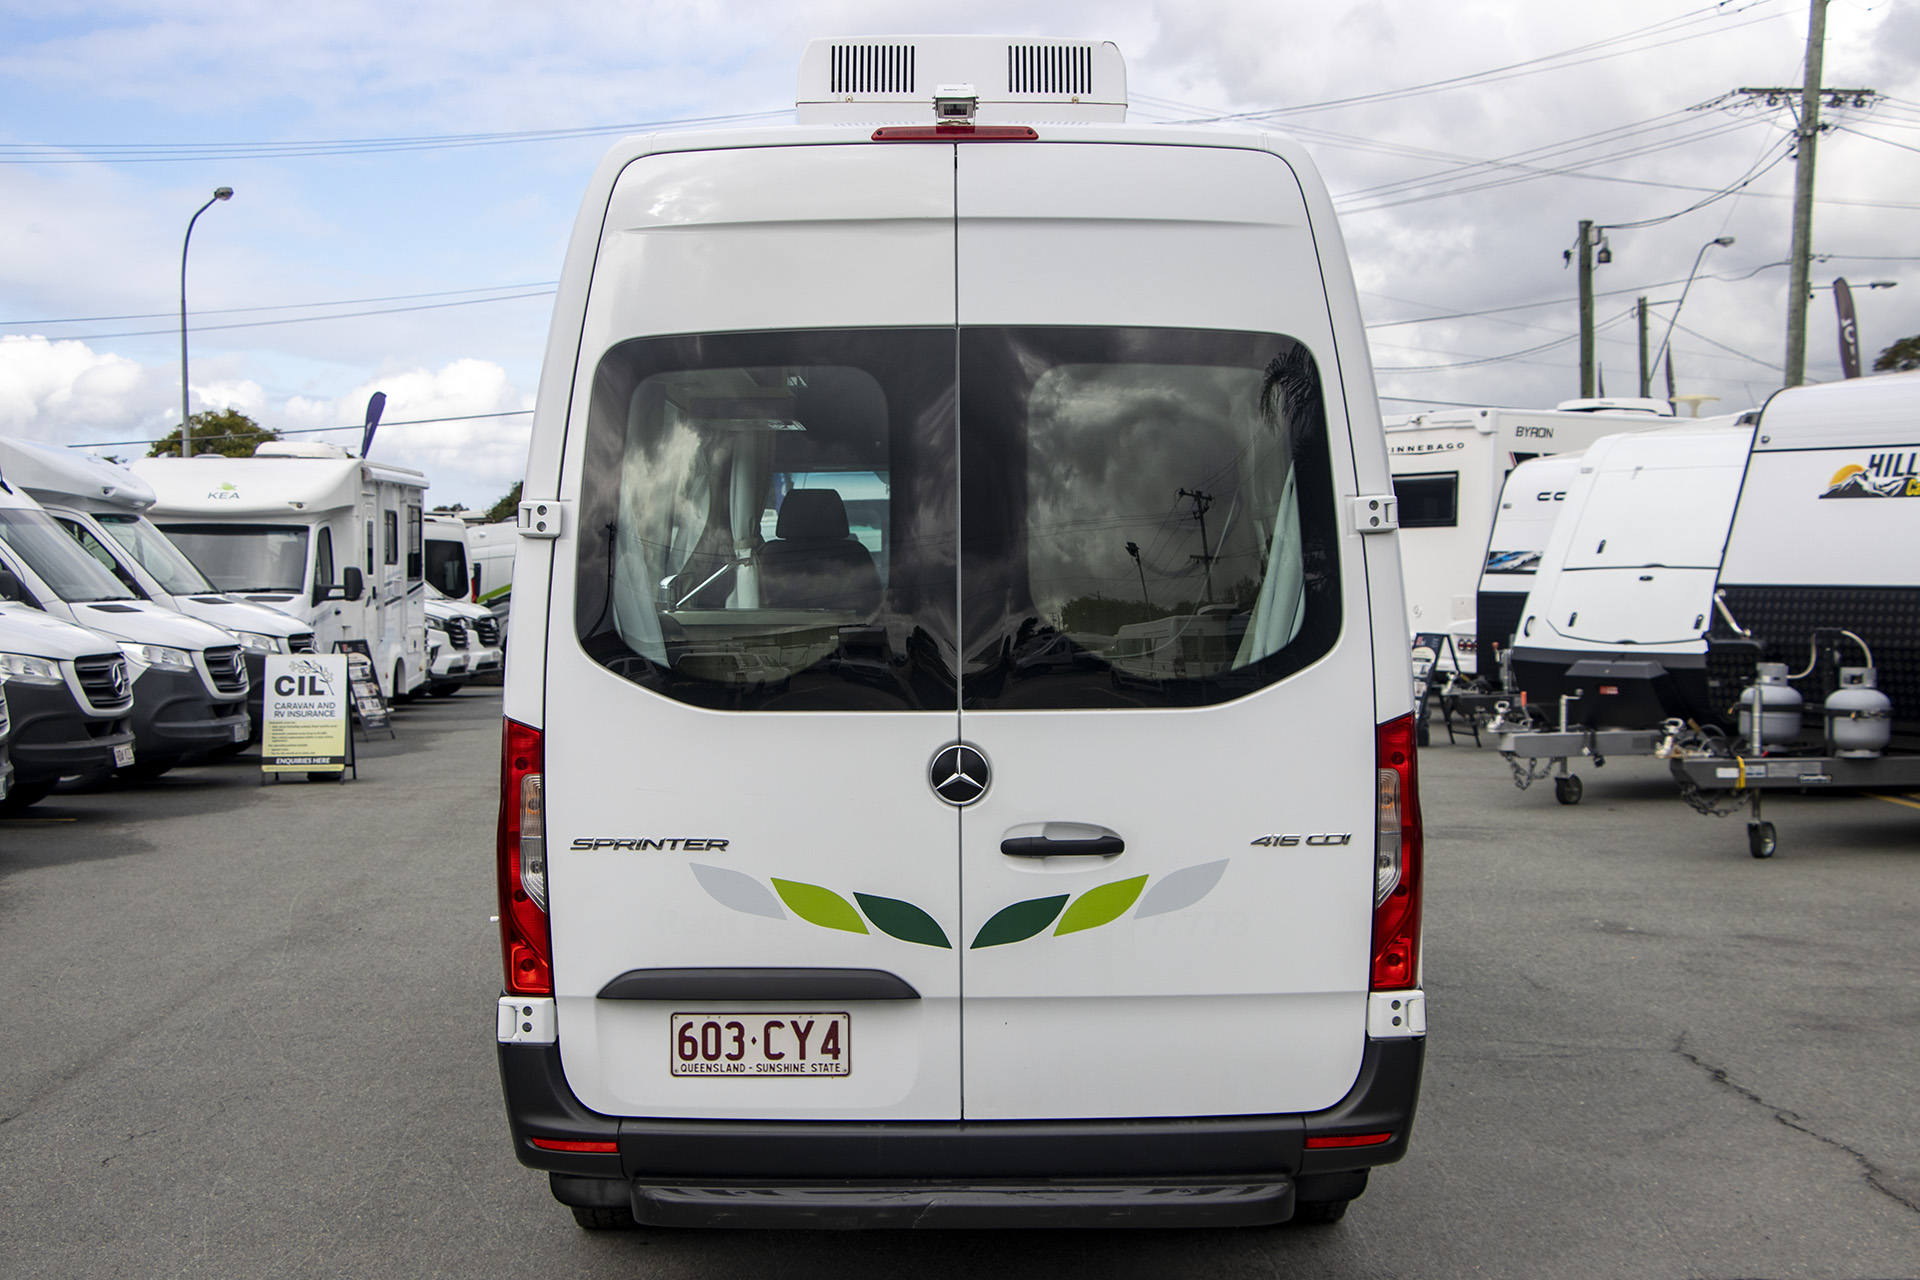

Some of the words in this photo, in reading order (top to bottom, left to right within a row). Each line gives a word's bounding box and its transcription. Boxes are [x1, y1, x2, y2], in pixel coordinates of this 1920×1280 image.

[1516, 426, 1554, 439] BYRON
[1387, 441, 1465, 453] INNEBAGO
[207, 491, 241, 501] KEA
[275, 676, 325, 697] CIL
[274, 702, 315, 710] CARAVAN
[317, 702, 336, 710] AND
[274, 710, 286, 718] RV
[287, 709, 336, 718] INSURANCE
[276, 757, 312, 766] ENQUIRIES
[570, 837, 729, 852] SPRINTER
[1250, 833, 1301, 847] 416
[1305, 832, 1352, 846] CDI
[680, 1063, 746, 1073] QUEENSLAND
[755, 1062, 806, 1073] SUNSHINE
[811, 1062, 841, 1073] STATE
